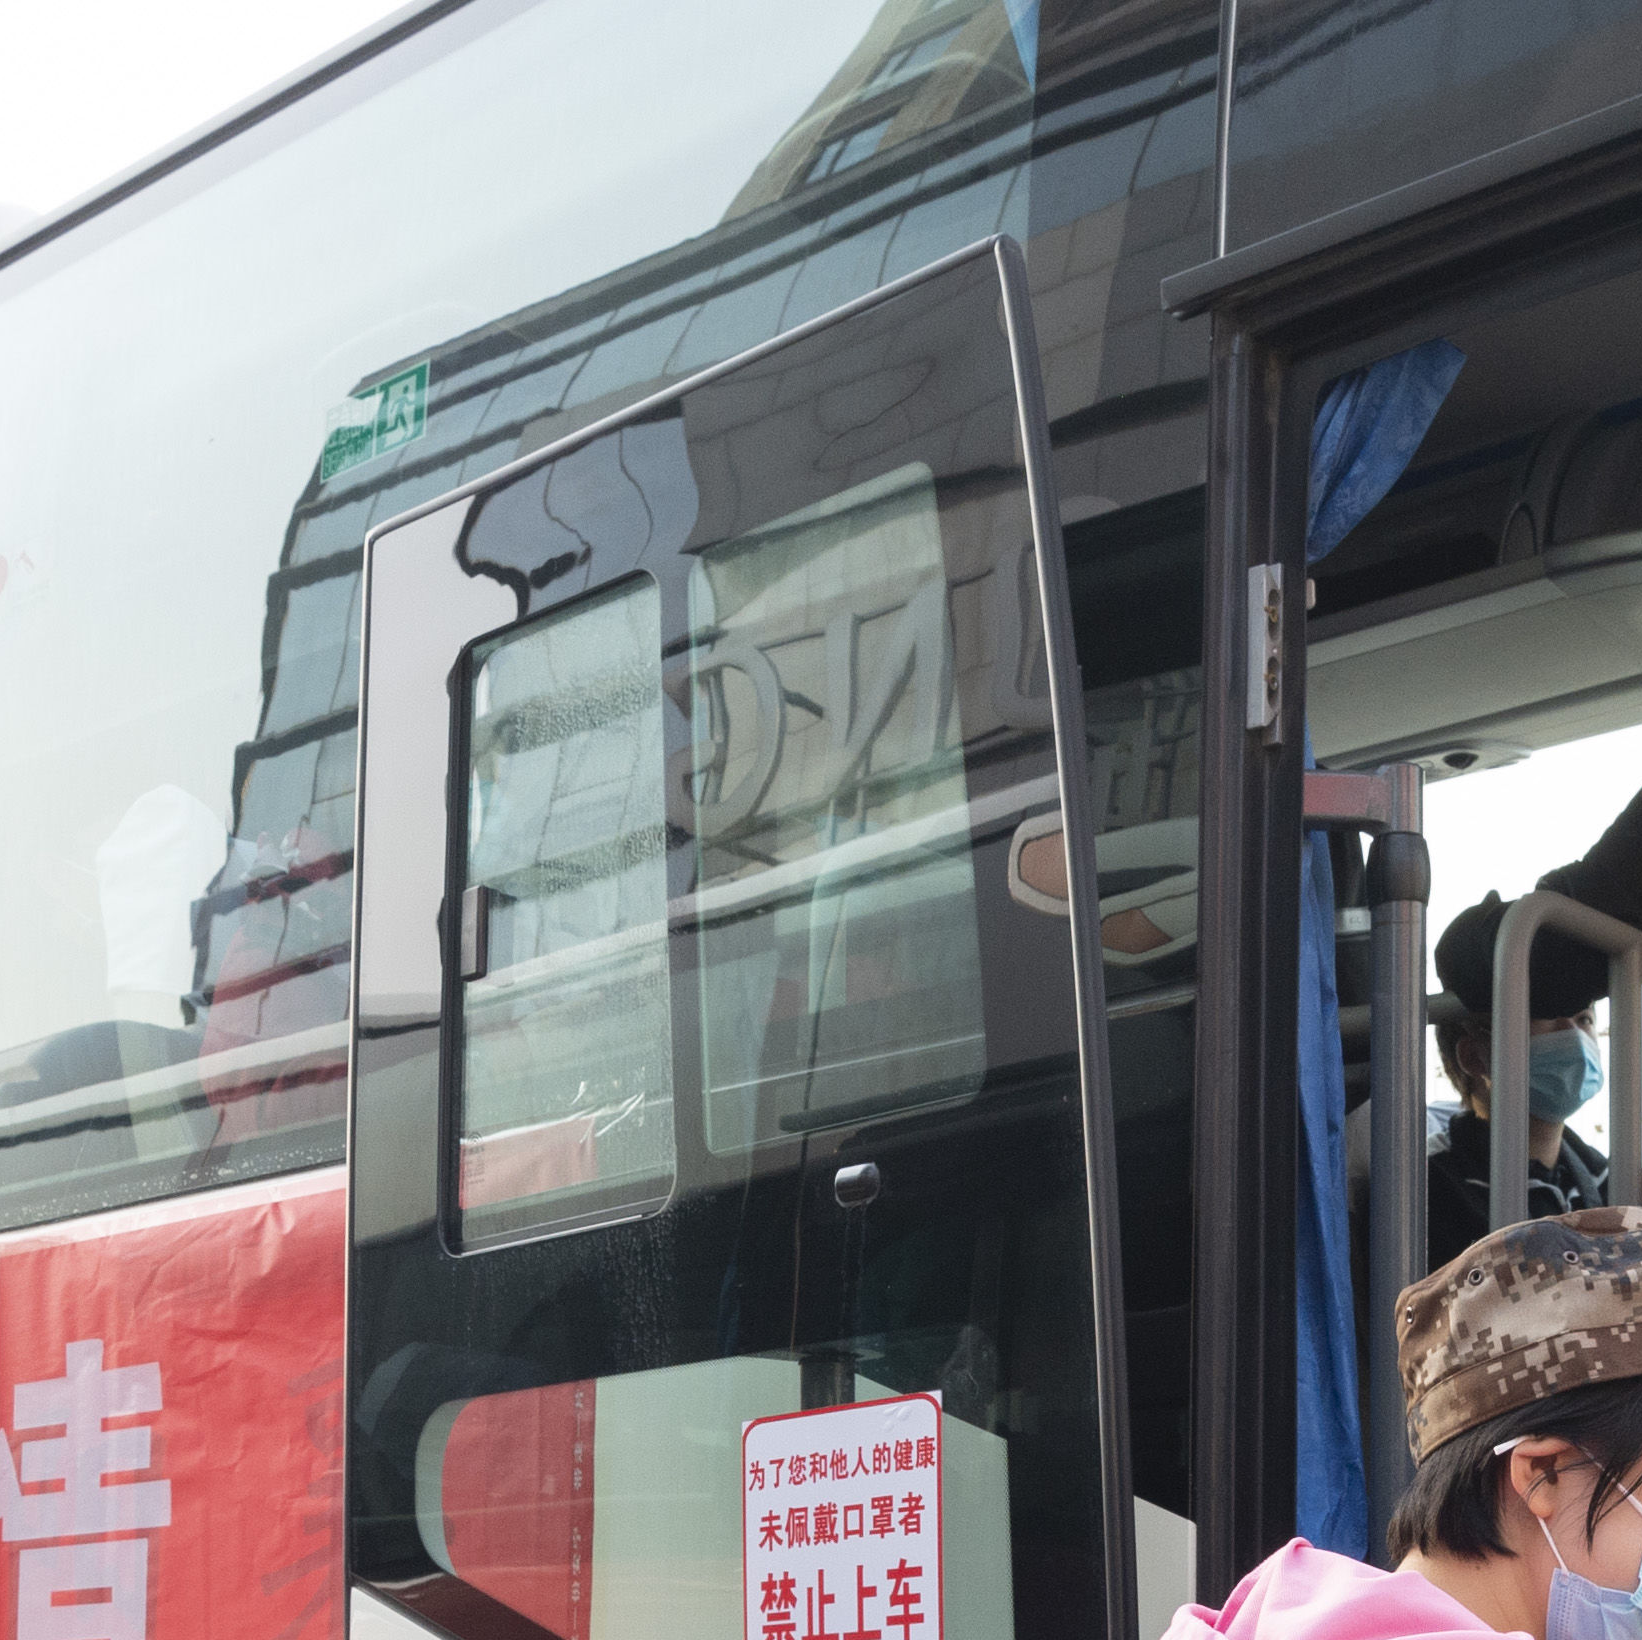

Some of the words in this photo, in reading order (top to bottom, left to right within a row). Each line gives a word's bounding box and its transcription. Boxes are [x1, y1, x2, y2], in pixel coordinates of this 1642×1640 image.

[749, 1436, 935, 1491] 为了您和他人的健康
[759, 1491, 925, 1552] 未佩戴口罩者
